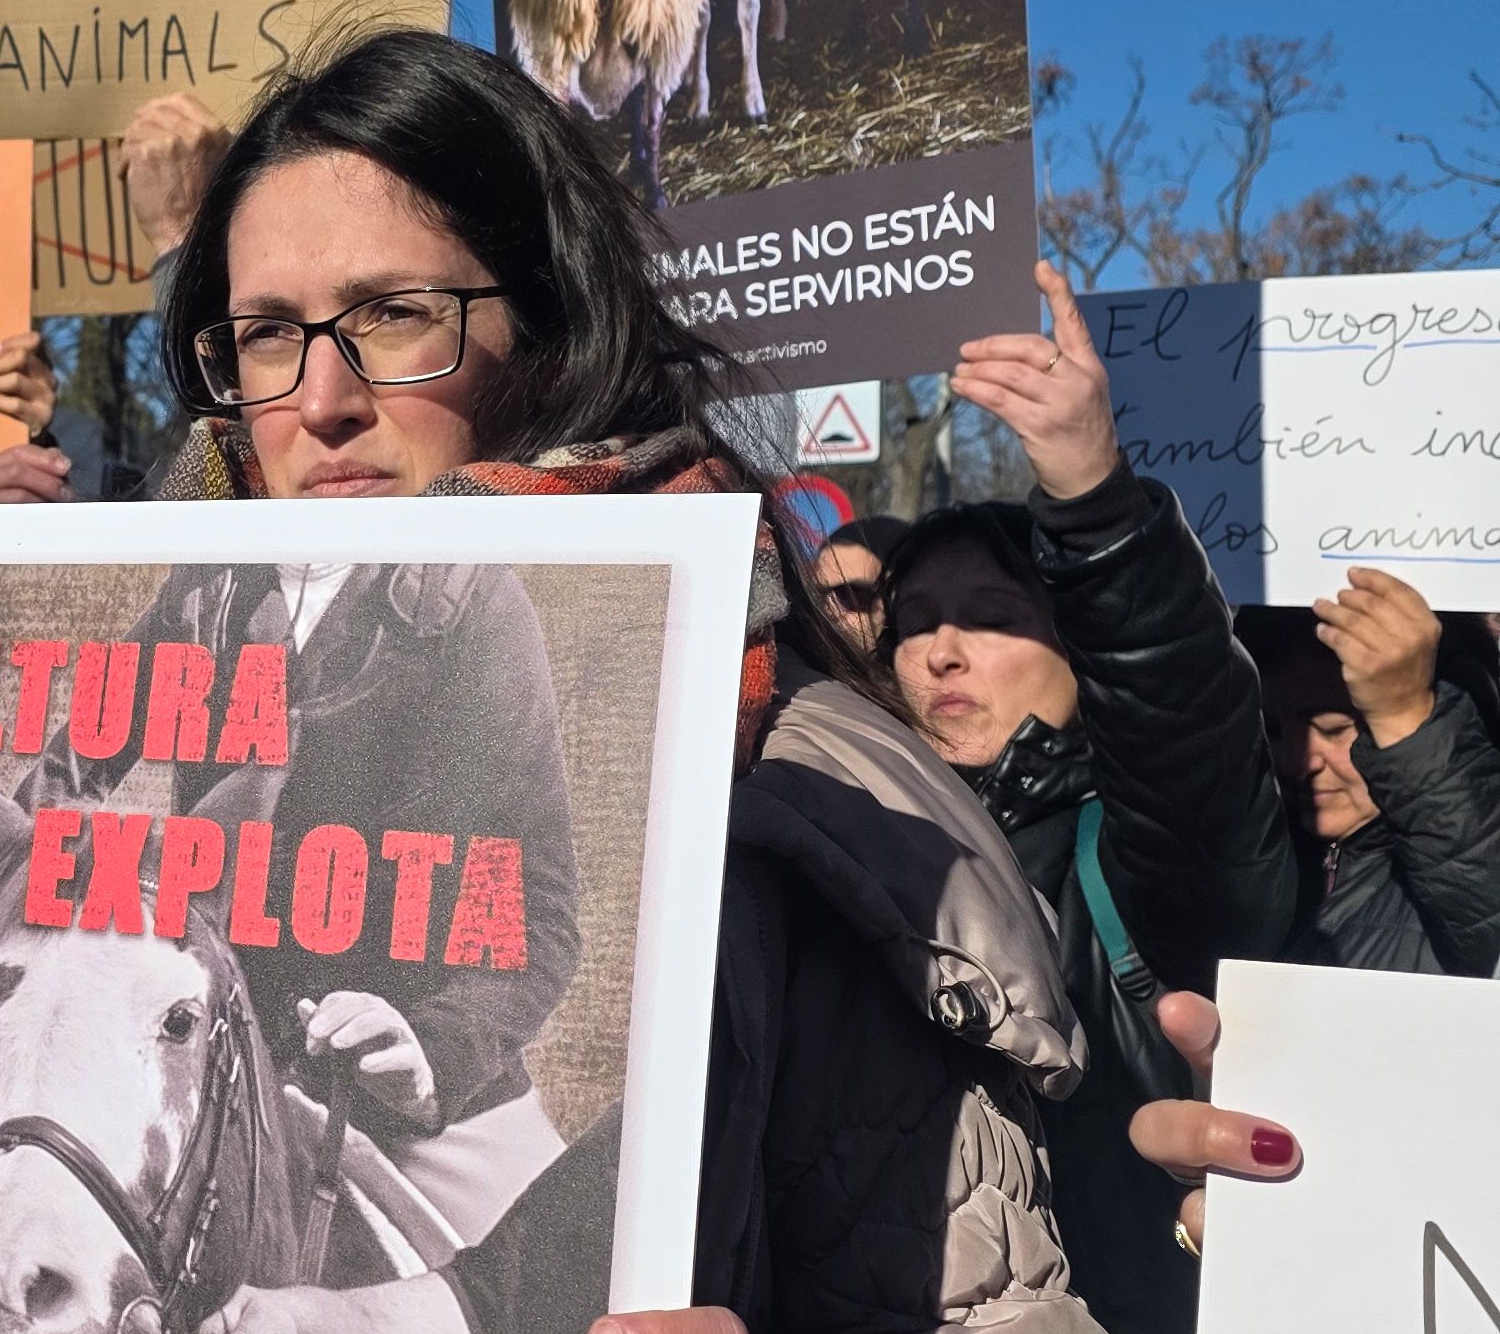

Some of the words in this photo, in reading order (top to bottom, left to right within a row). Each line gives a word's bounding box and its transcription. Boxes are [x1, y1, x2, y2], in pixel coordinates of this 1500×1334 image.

[791, 220, 854, 263] NO
[864, 190, 996, 251] ESTÁN
[745, 249, 975, 317] SERVIRNOS
[1104, 288, 1189, 362] El
[1217, 303, 1500, 387] progres
[24, 808, 529, 970] EXPLOTA
